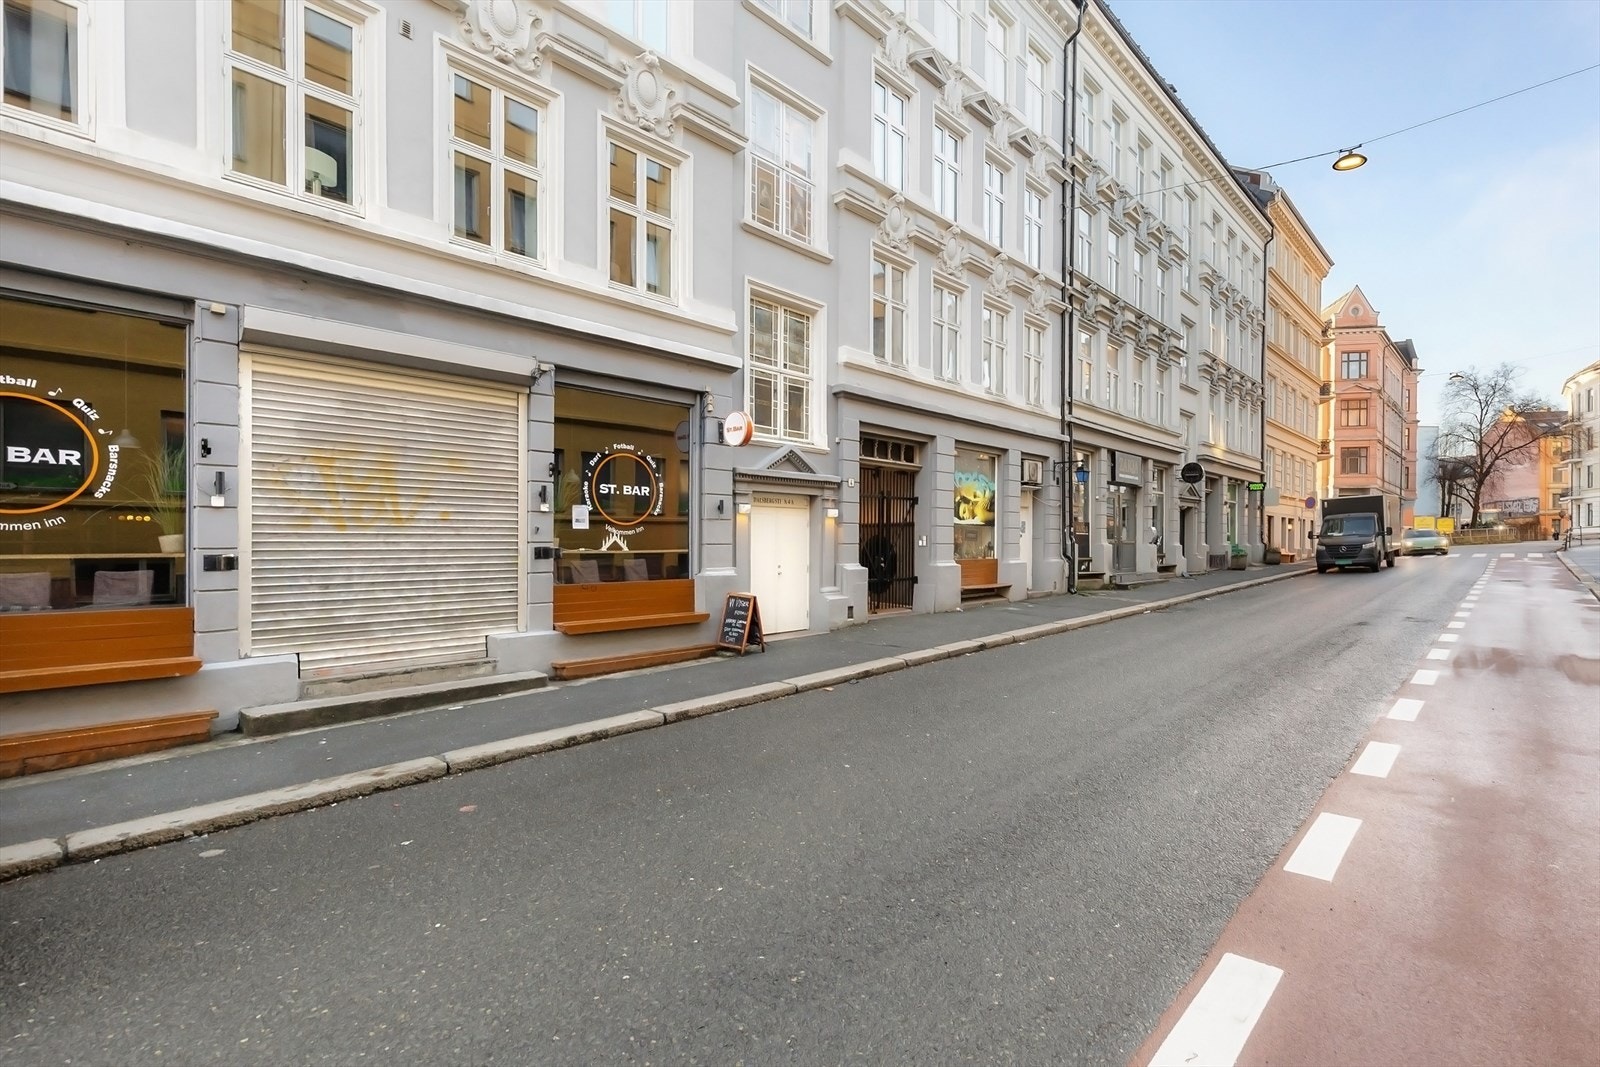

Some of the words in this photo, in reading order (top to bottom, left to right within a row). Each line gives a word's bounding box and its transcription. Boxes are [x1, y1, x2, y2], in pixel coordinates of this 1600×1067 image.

[72, 398, 100, 421] Quiz
[6, 446, 81, 466] BAR
[613, 443, 635, 451] Fotball
[589, 452, 602, 467] Dart
[94, 444, 119, 499] Barsnacks
[583, 481, 593, 511] Karaoke
[599, 483, 620, 495] ST.
[623, 485, 650, 496] BAR
[653, 482, 664, 516] Barsnacks
[43, 516, 66, 528] inn
